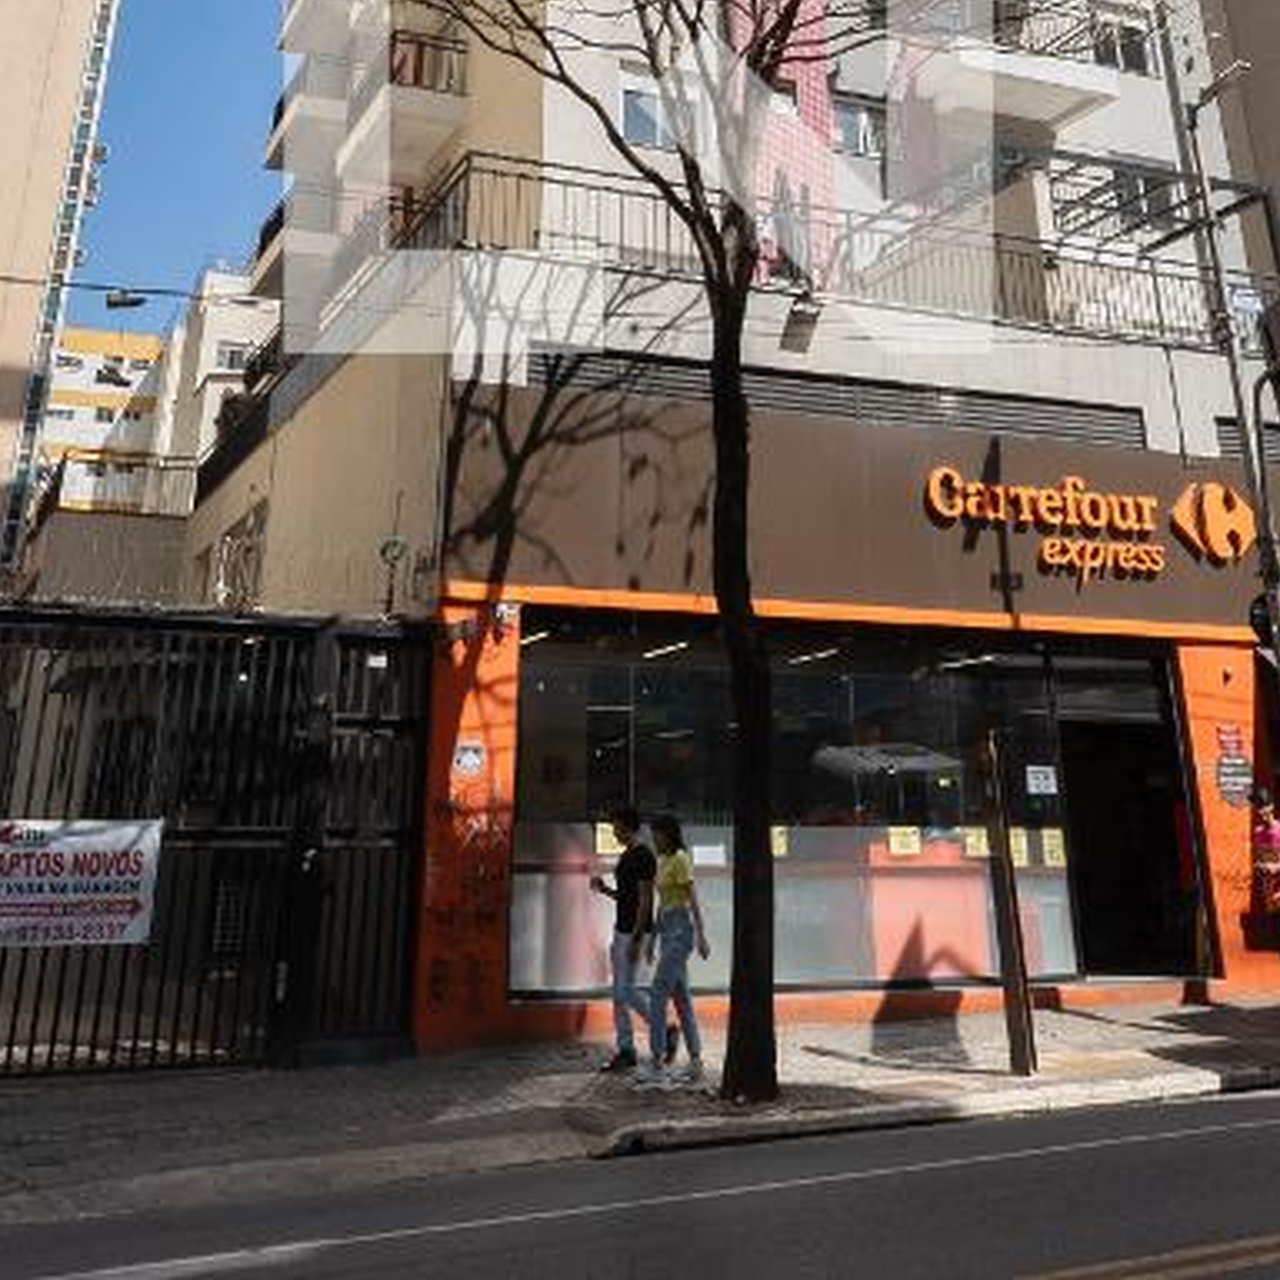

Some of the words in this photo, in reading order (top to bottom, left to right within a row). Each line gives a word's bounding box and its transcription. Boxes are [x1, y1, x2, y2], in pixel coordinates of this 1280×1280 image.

[928, 467, 1159, 531] Carrefour
[1041, 537, 1166, 585] express
[70, 850, 145, 878] NOVOS
